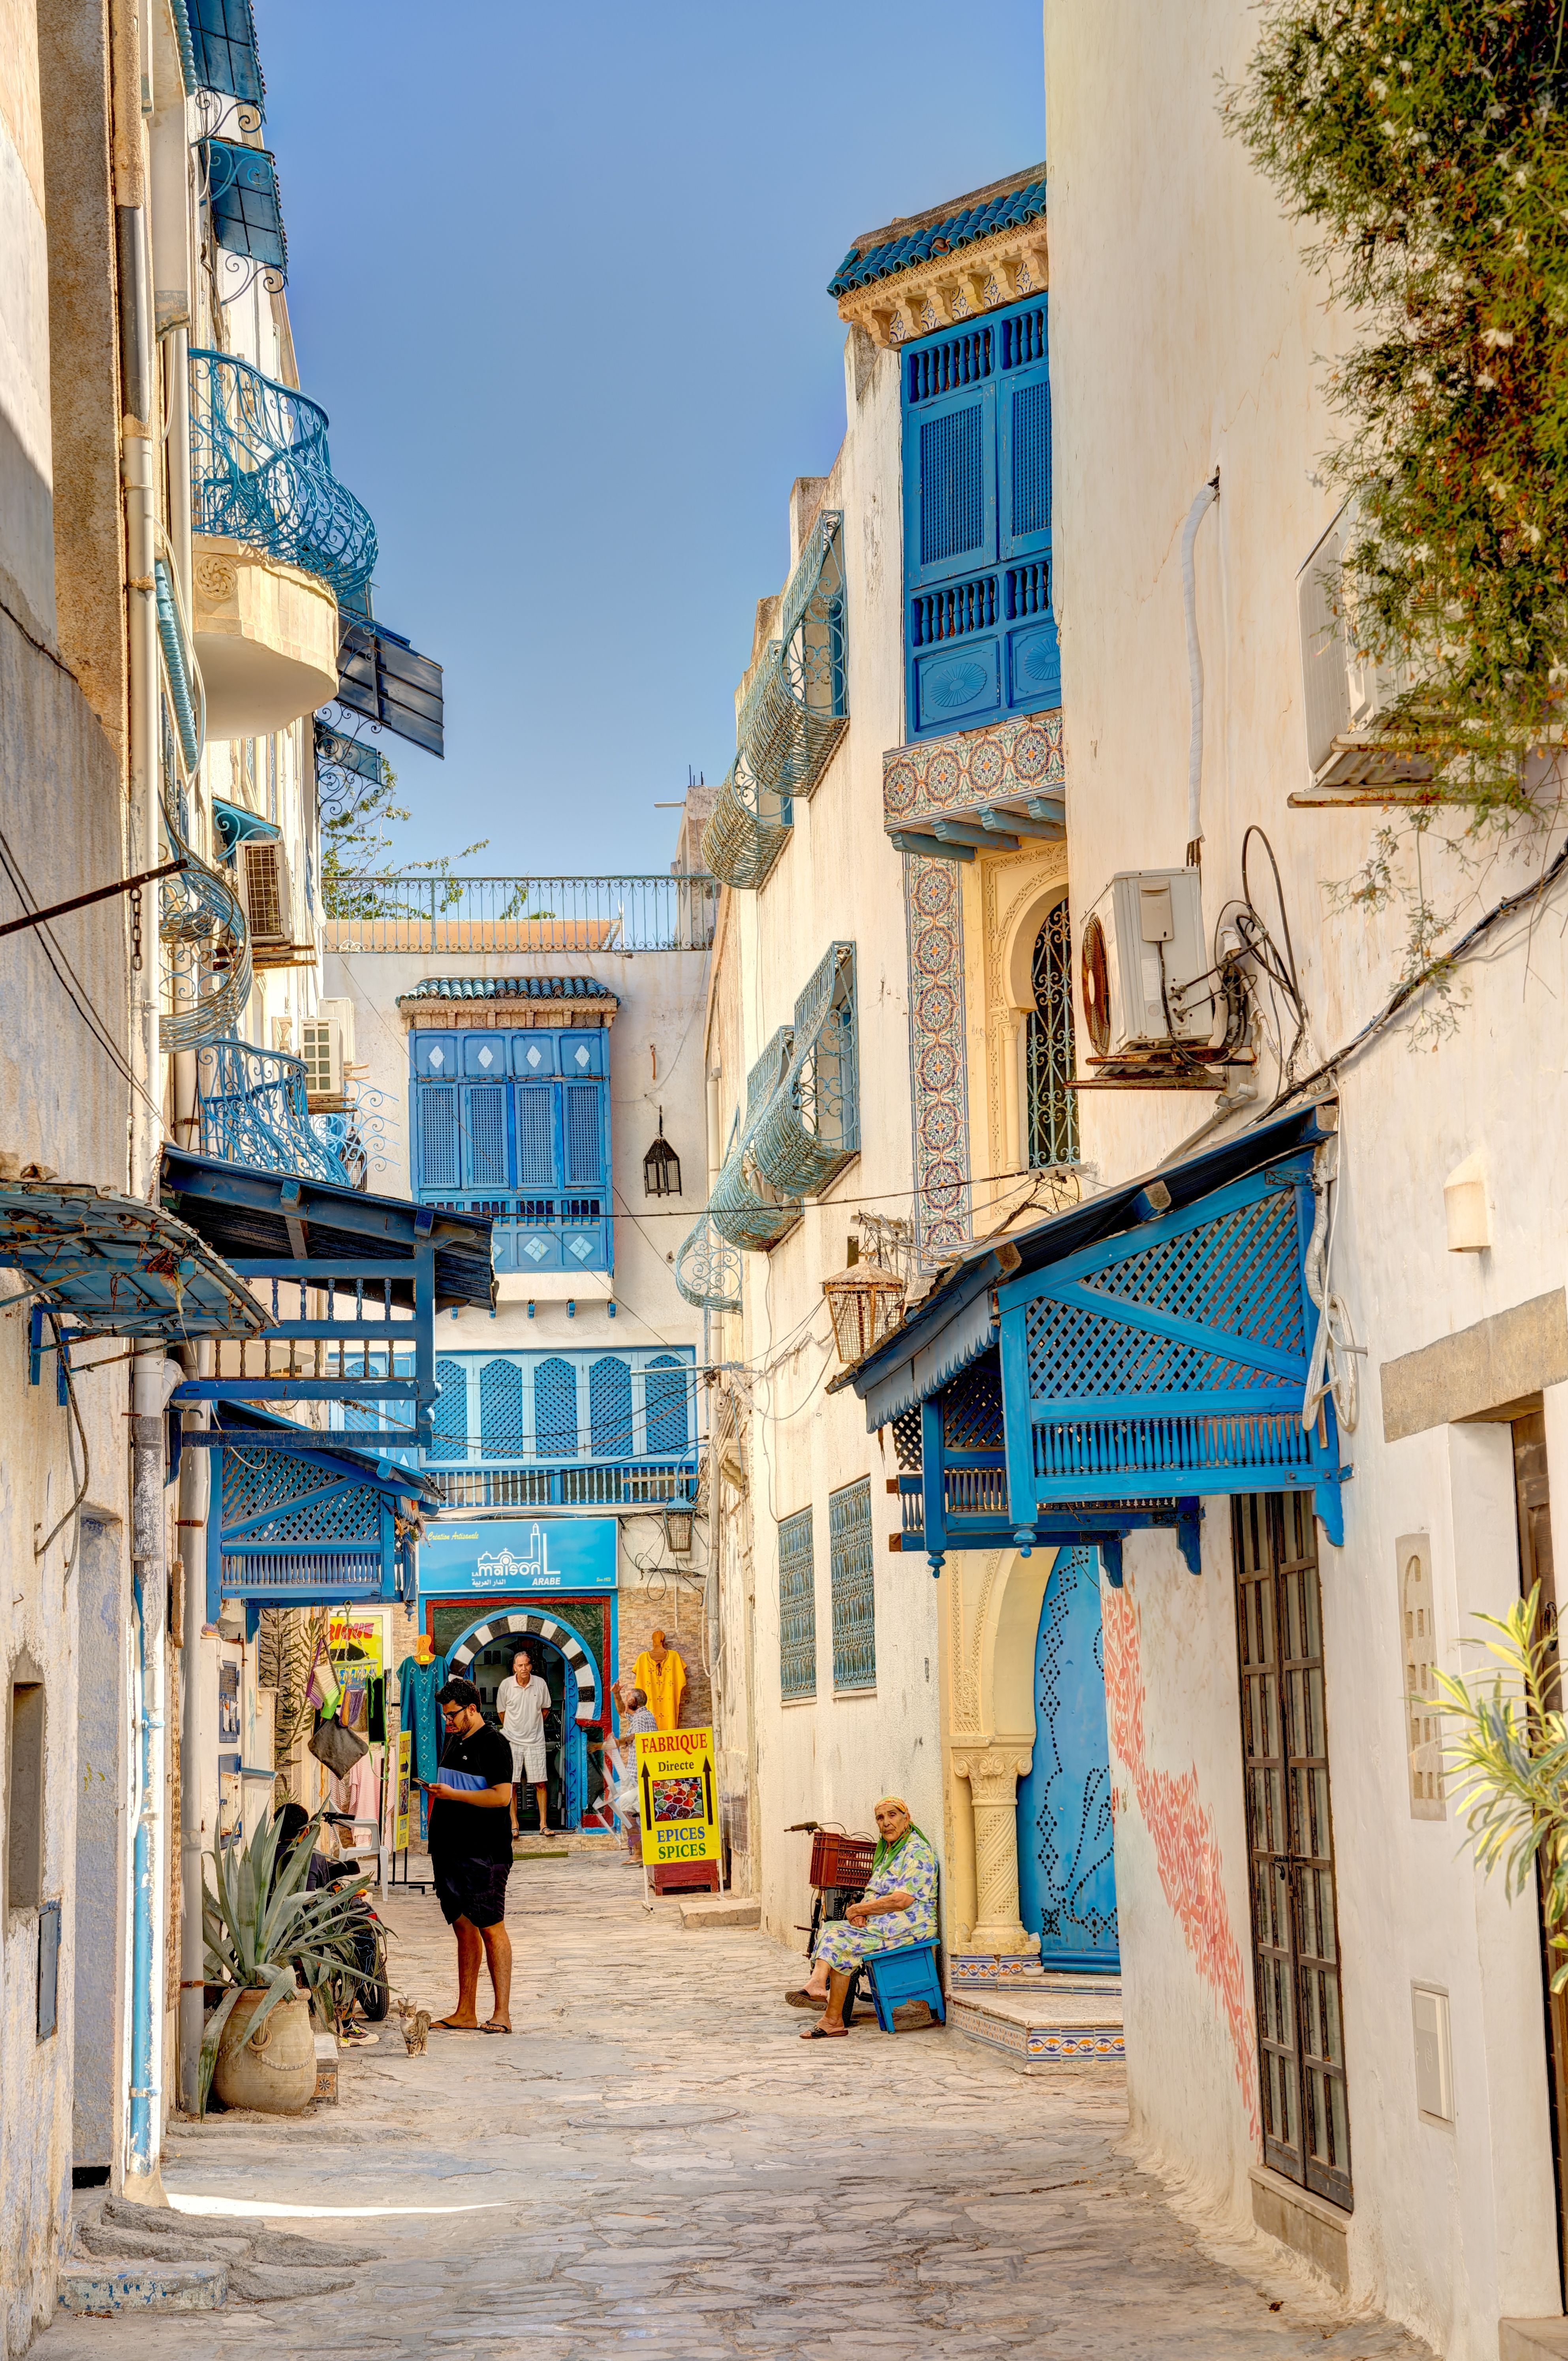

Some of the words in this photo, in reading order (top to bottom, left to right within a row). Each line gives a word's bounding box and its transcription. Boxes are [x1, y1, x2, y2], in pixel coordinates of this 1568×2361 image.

[451, 1531, 479, 1540] Artisanale
[479, 1558, 541, 1576] maison
[471, 1579, 491, 1587] العربية
[532, 1577, 561, 1585] ARABE
[641, 1733, 707, 1755] FABRIQUE
[658, 1760, 694, 1772] Directe
[656, 1826, 705, 1843] EPICES
[658, 1842, 706, 1859] SPICES
